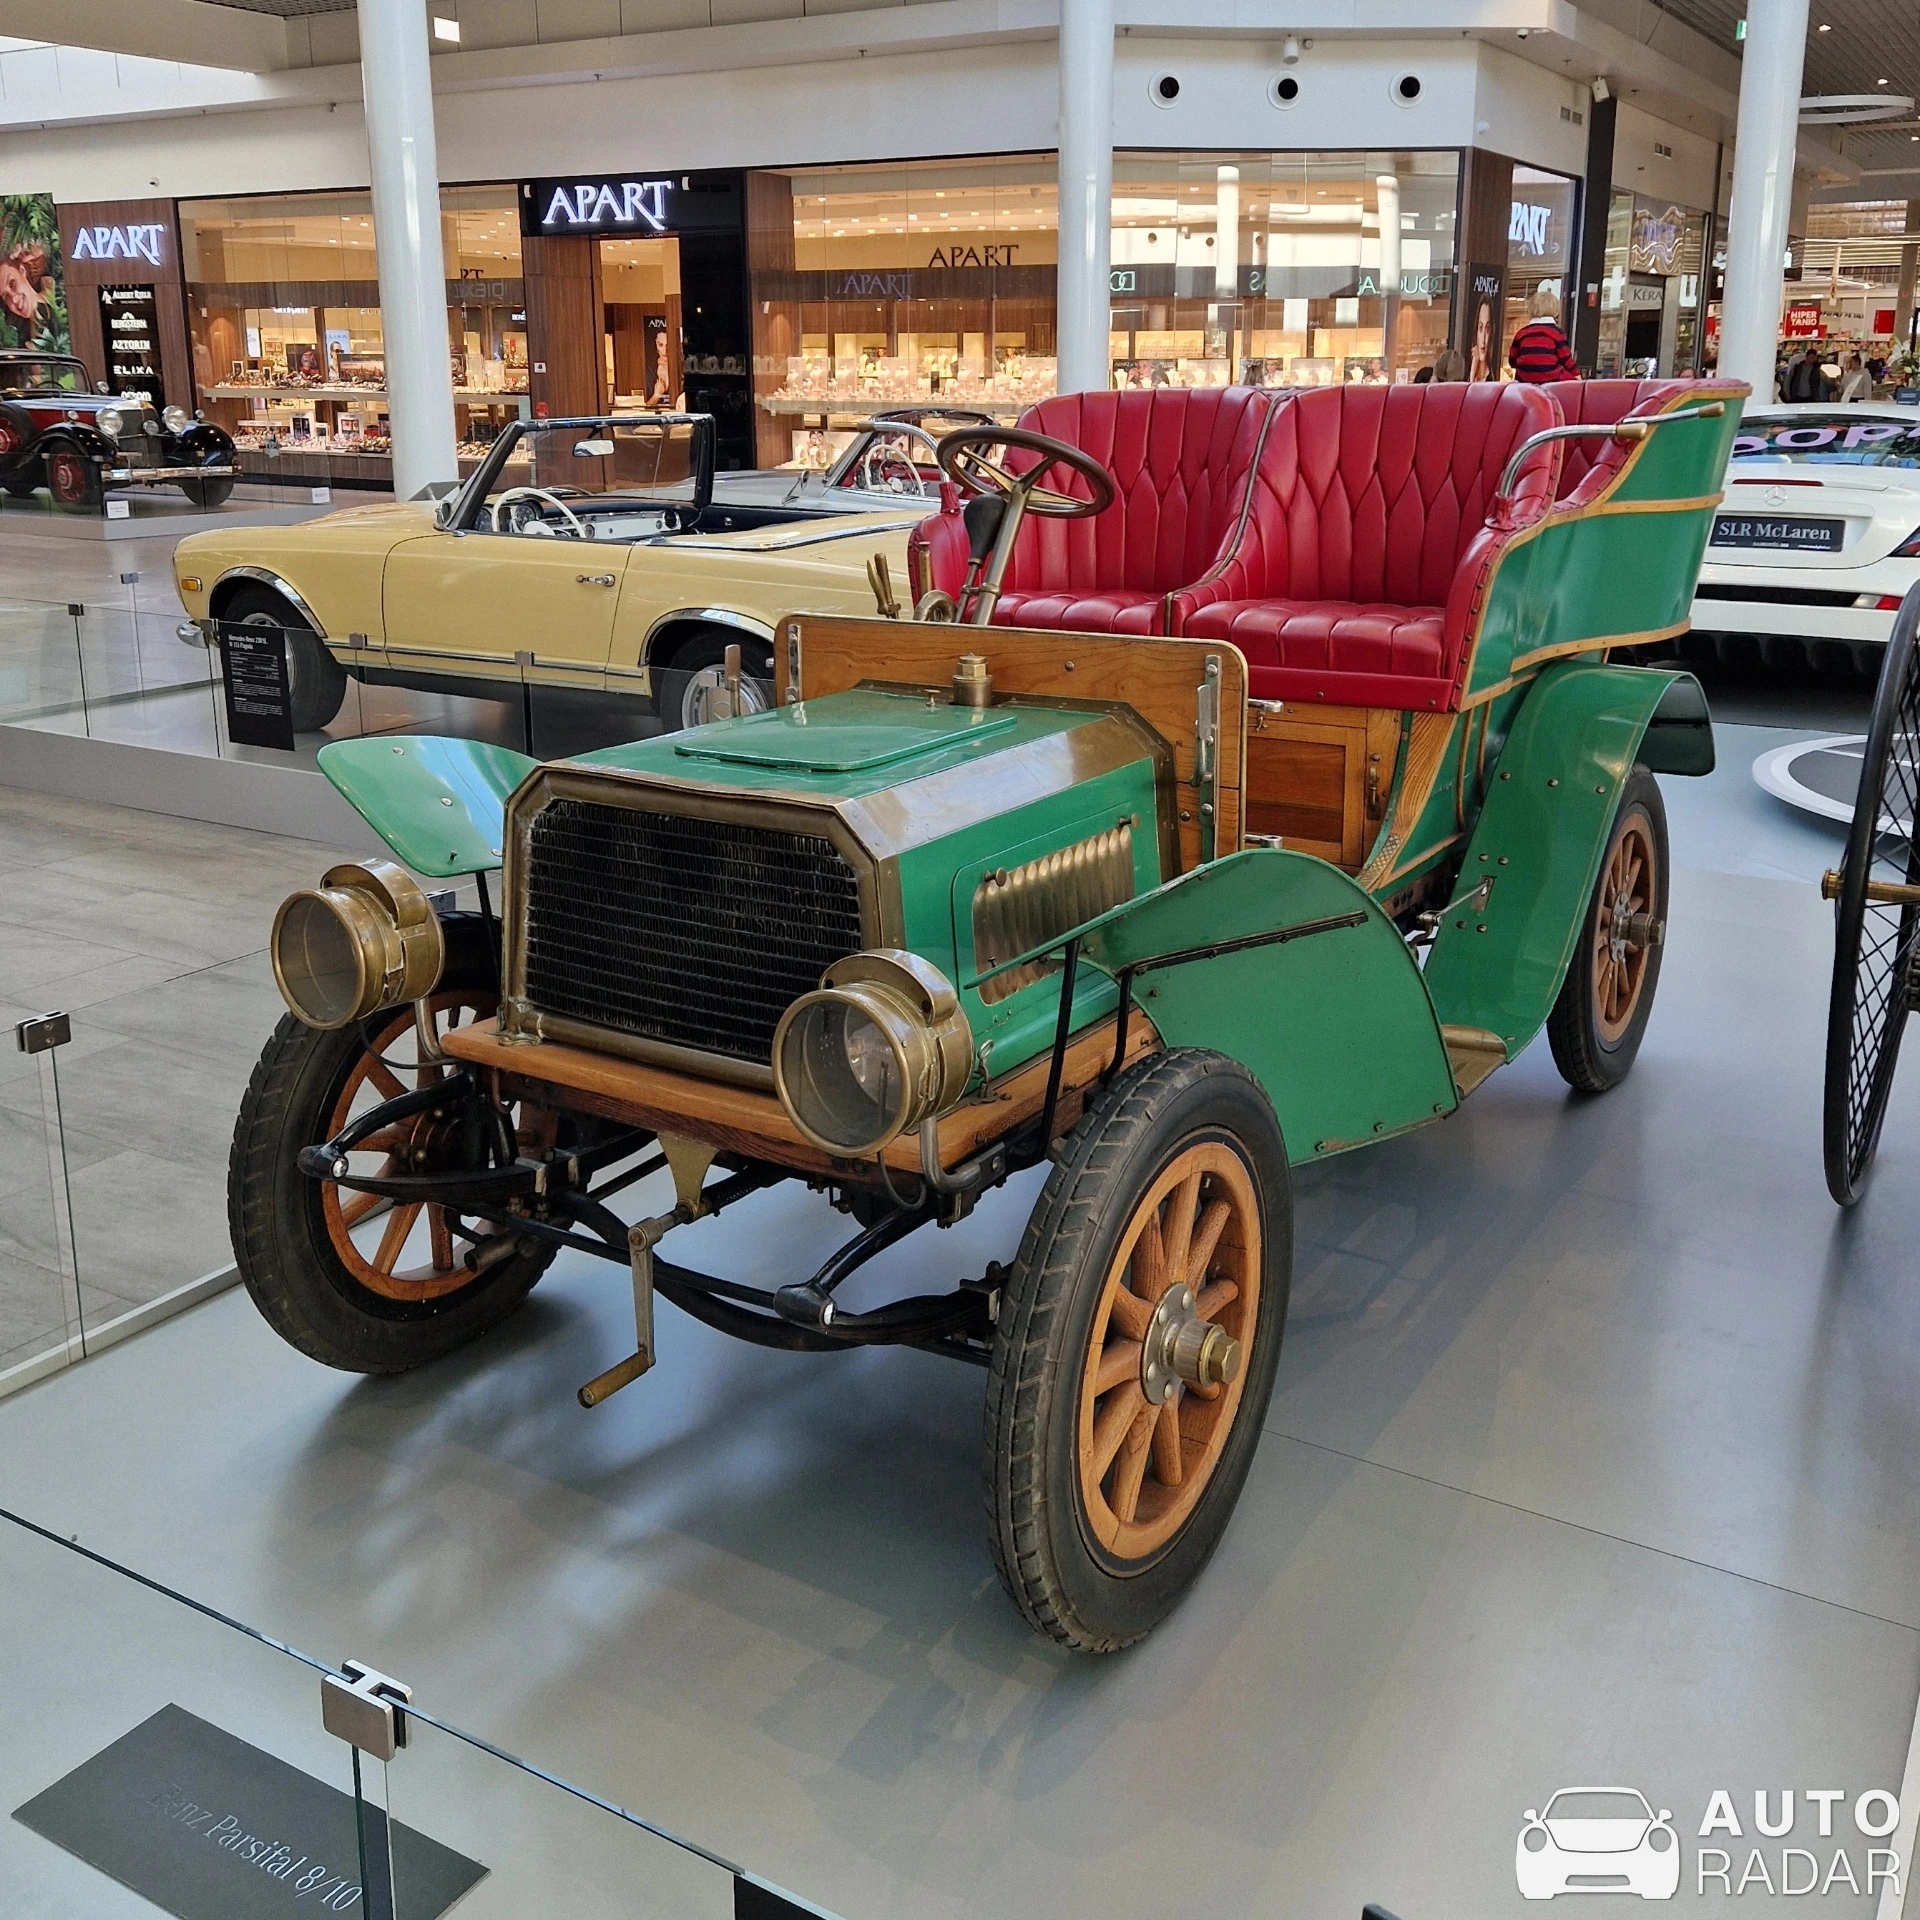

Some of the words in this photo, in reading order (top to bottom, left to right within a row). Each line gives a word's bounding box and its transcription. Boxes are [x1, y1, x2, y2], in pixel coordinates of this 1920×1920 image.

[542, 181, 672, 230] APART
[1508, 202, 1551, 255] PART
[71, 224, 164, 266] APART
[928, 245, 1019, 267] APART
[1790, 310, 1818, 319] HIPER
[1790, 318, 1818, 326] TANIO
[113, 365, 154, 375] ELIXA
[1718, 522, 1752, 537] SLR
[1755, 524, 1831, 541] McLaren
[203, 1814, 308, 1880] Parsifal
[296, 1865, 363, 1911] 8/10
